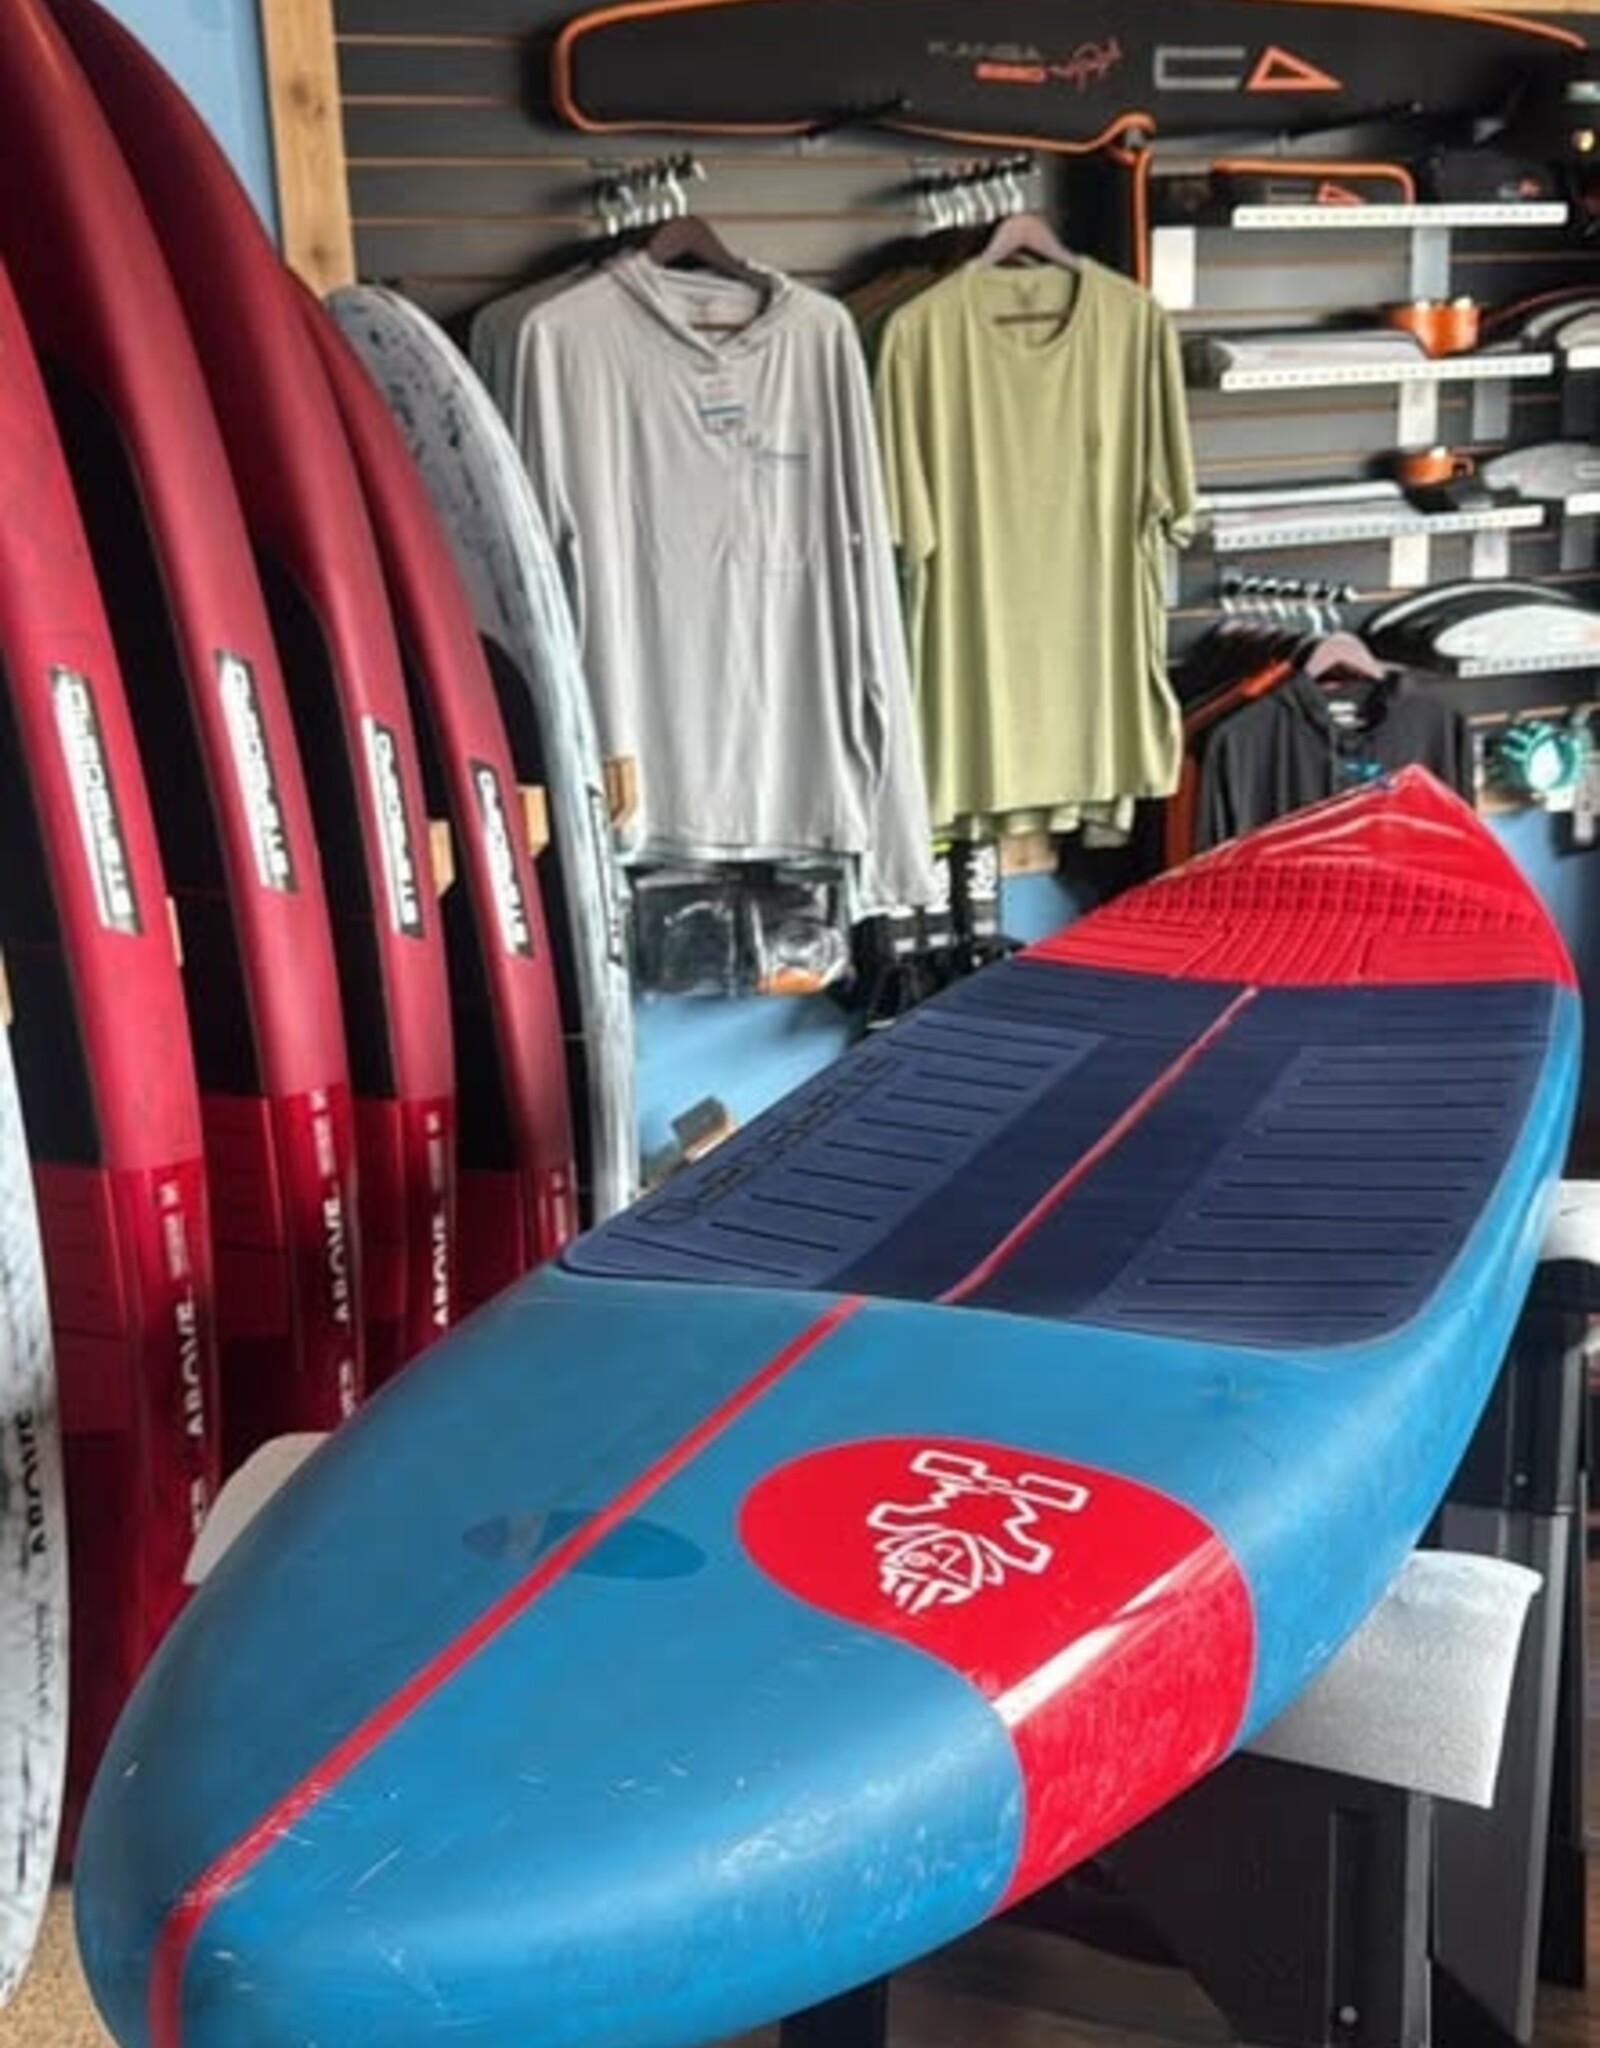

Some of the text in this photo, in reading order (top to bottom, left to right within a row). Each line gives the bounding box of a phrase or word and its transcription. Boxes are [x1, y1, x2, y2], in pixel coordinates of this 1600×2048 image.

[324, 1197, 349, 1324] ABOVE
[431, 1213, 451, 1327] ABOVE
[174, 1301, 205, 1437] ABOVE
